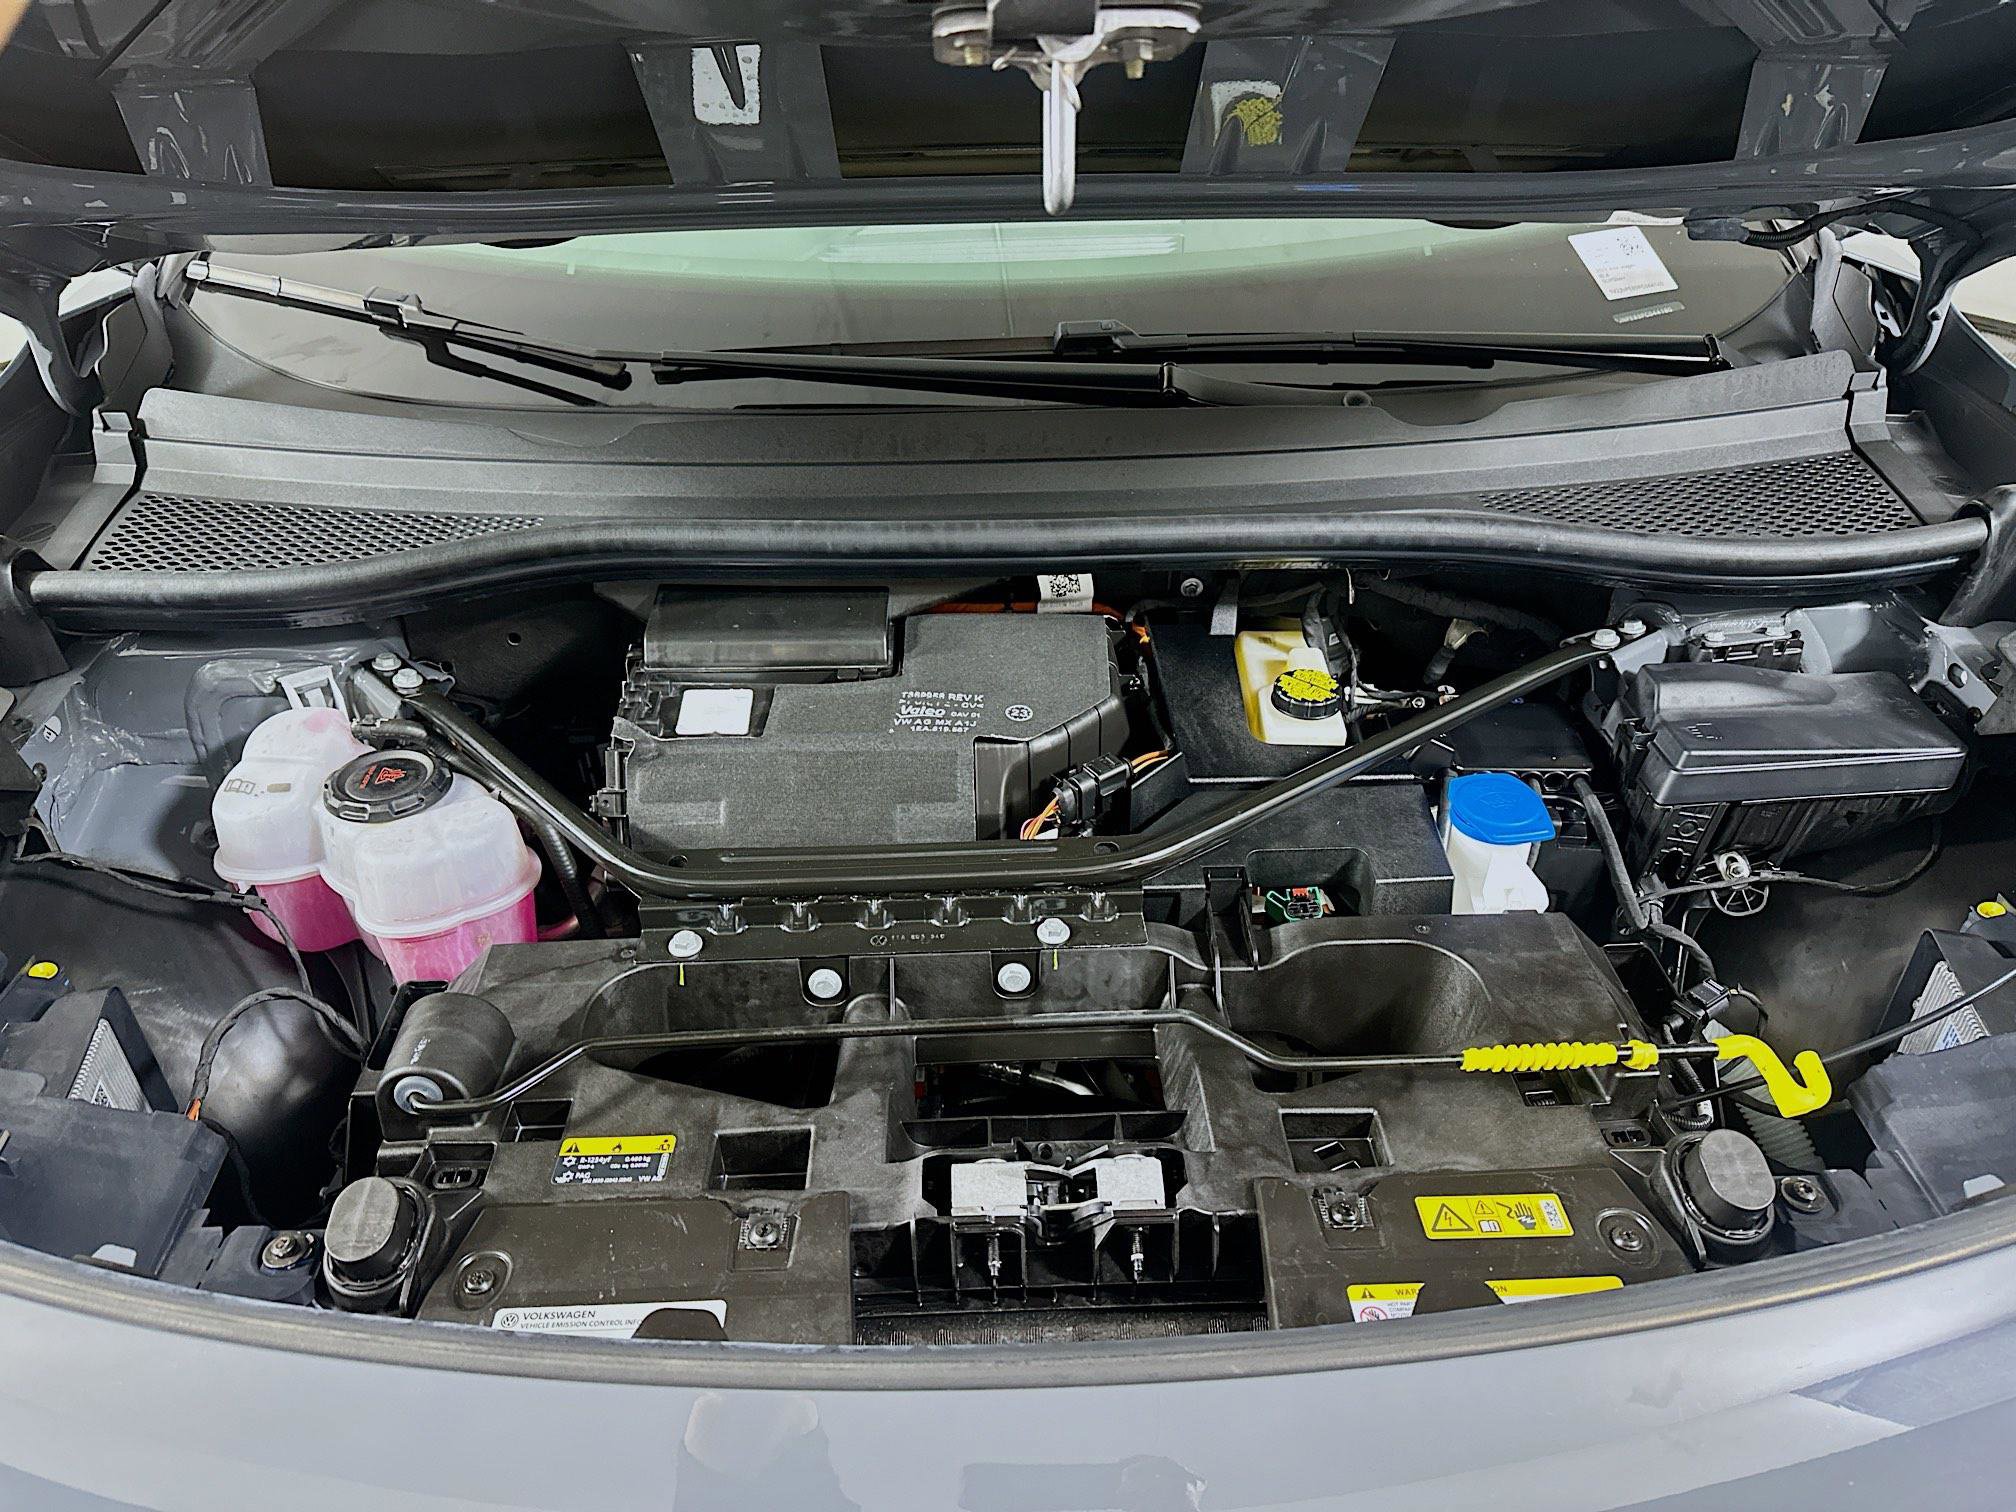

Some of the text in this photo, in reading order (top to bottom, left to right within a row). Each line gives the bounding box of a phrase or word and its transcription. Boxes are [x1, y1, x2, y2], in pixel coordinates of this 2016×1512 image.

[948, 693, 972, 701] REV
[974, 694, 984, 702] K
[901, 704, 946, 716] Valeo
[1011, 708, 1027, 717] 23
[894, 718, 912, 726] VW
[575, 1171, 591, 1179] PAG
[523, 1310, 596, 1320] VOLKSWAGEN
[589, 1319, 623, 1327] CONTROL
